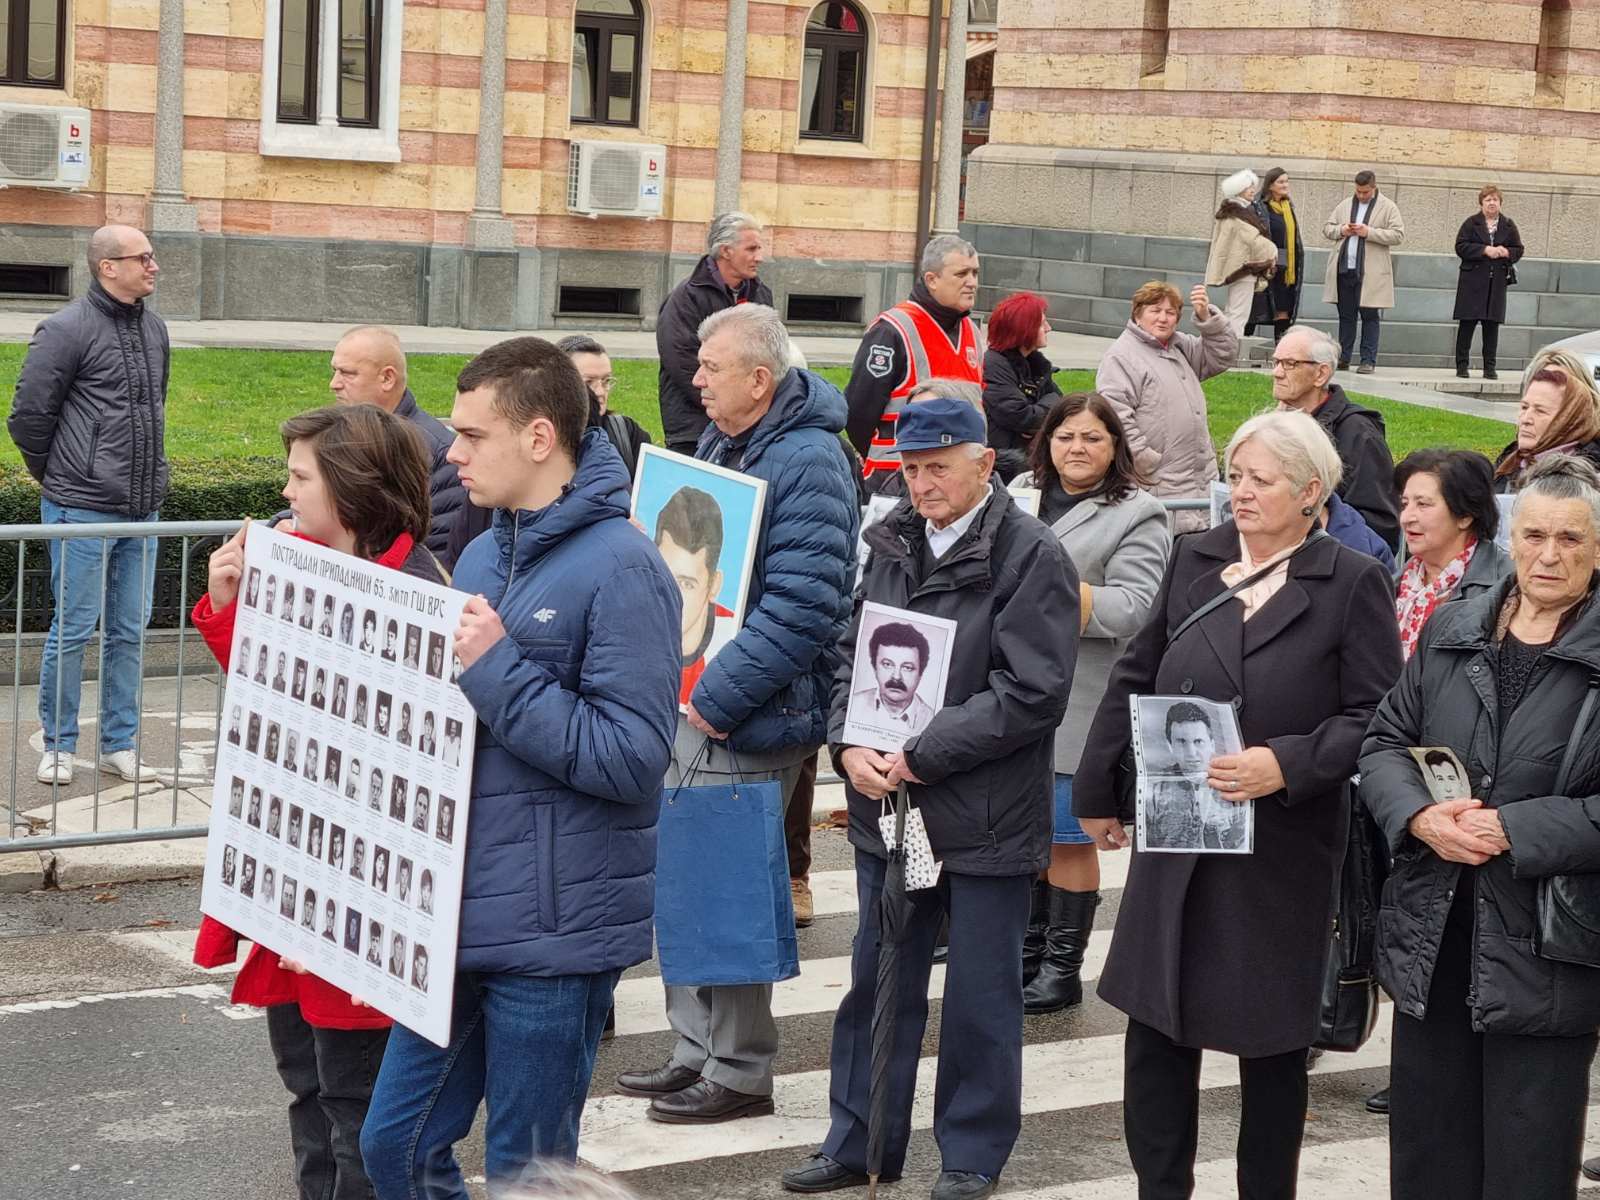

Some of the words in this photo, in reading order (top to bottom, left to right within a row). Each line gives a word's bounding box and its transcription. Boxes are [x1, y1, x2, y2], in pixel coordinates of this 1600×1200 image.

[271, 542, 319, 575] ПОСТРАДАЛИ
[319, 559, 373, 593] ПРИПАДНИЦИ
[373, 578, 386, 599] 65.
[410, 590, 426, 613] ГШ
[427, 595, 446, 618] ВРС
[532, 607, 557, 623] 4F
